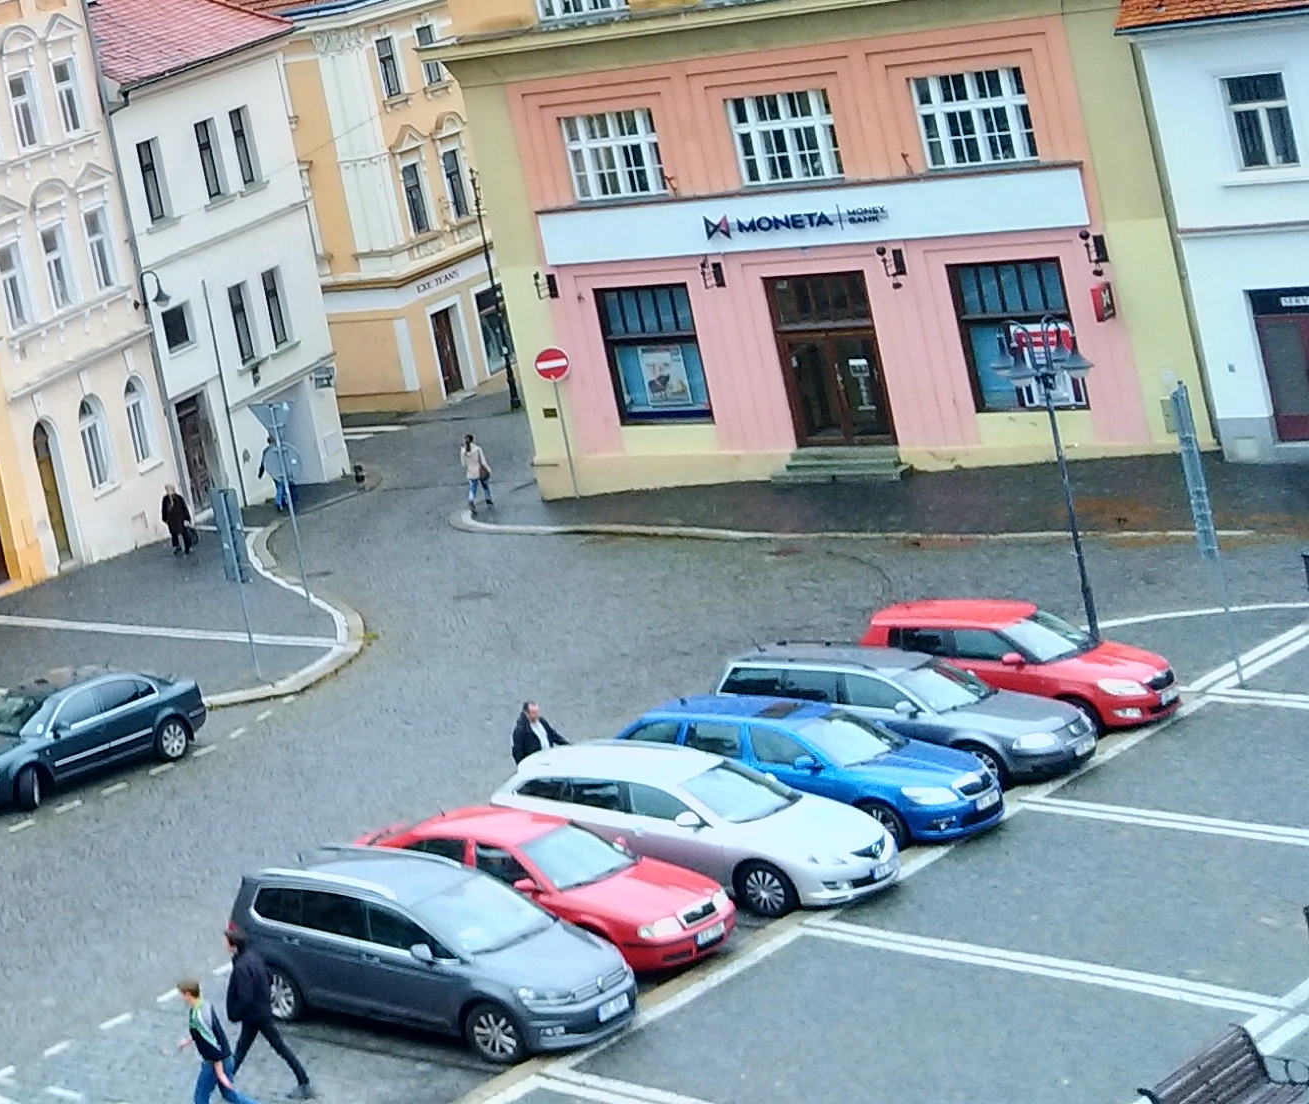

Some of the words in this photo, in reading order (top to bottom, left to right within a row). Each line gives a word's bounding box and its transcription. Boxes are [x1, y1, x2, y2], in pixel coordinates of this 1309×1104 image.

[847, 205, 886, 216] MONEY
[736, 211, 834, 234] MONETA
[848, 214, 881, 224] BANK
